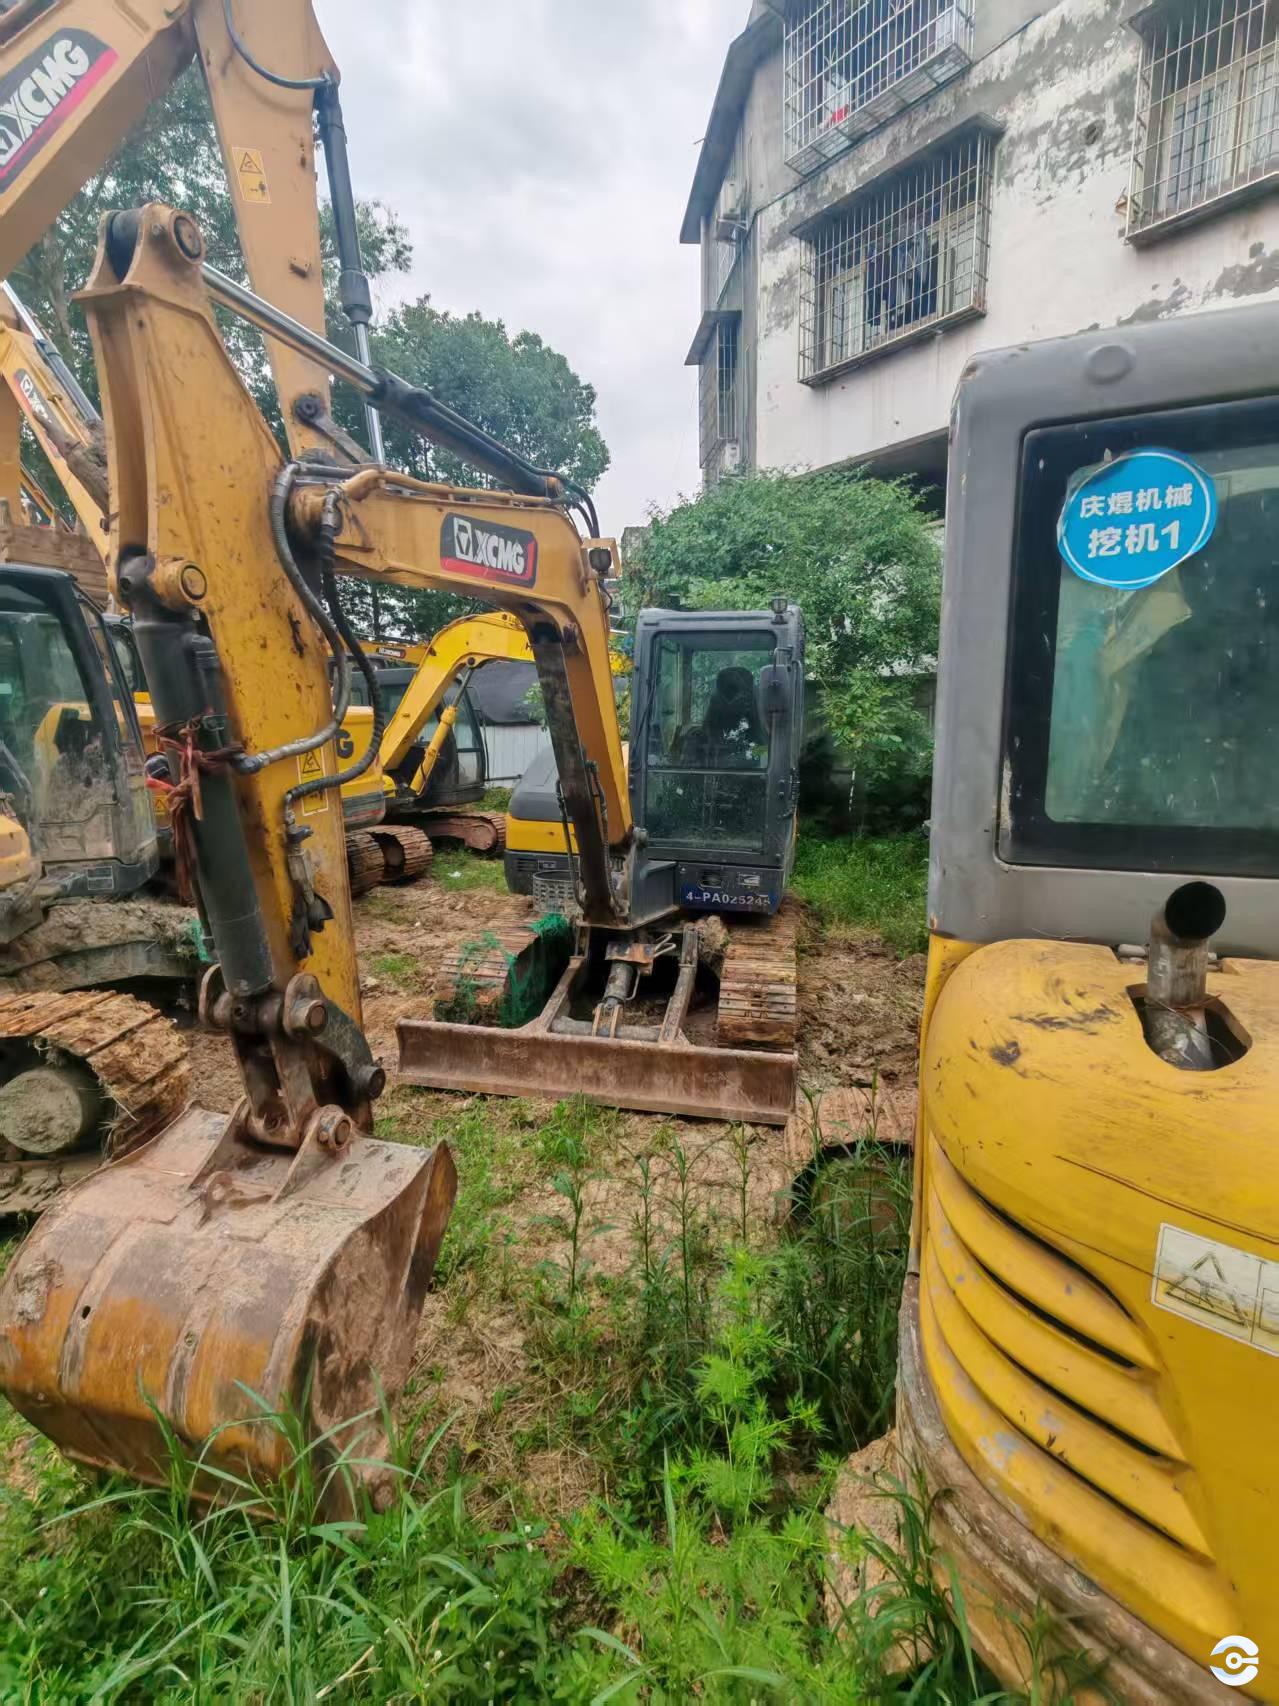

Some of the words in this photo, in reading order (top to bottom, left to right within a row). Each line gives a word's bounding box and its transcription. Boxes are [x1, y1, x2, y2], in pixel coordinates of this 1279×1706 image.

[0, 39, 90, 145] XCMG
[474, 528, 525, 575] XCMG
[1087, 520, 1181, 558] 挖机1
